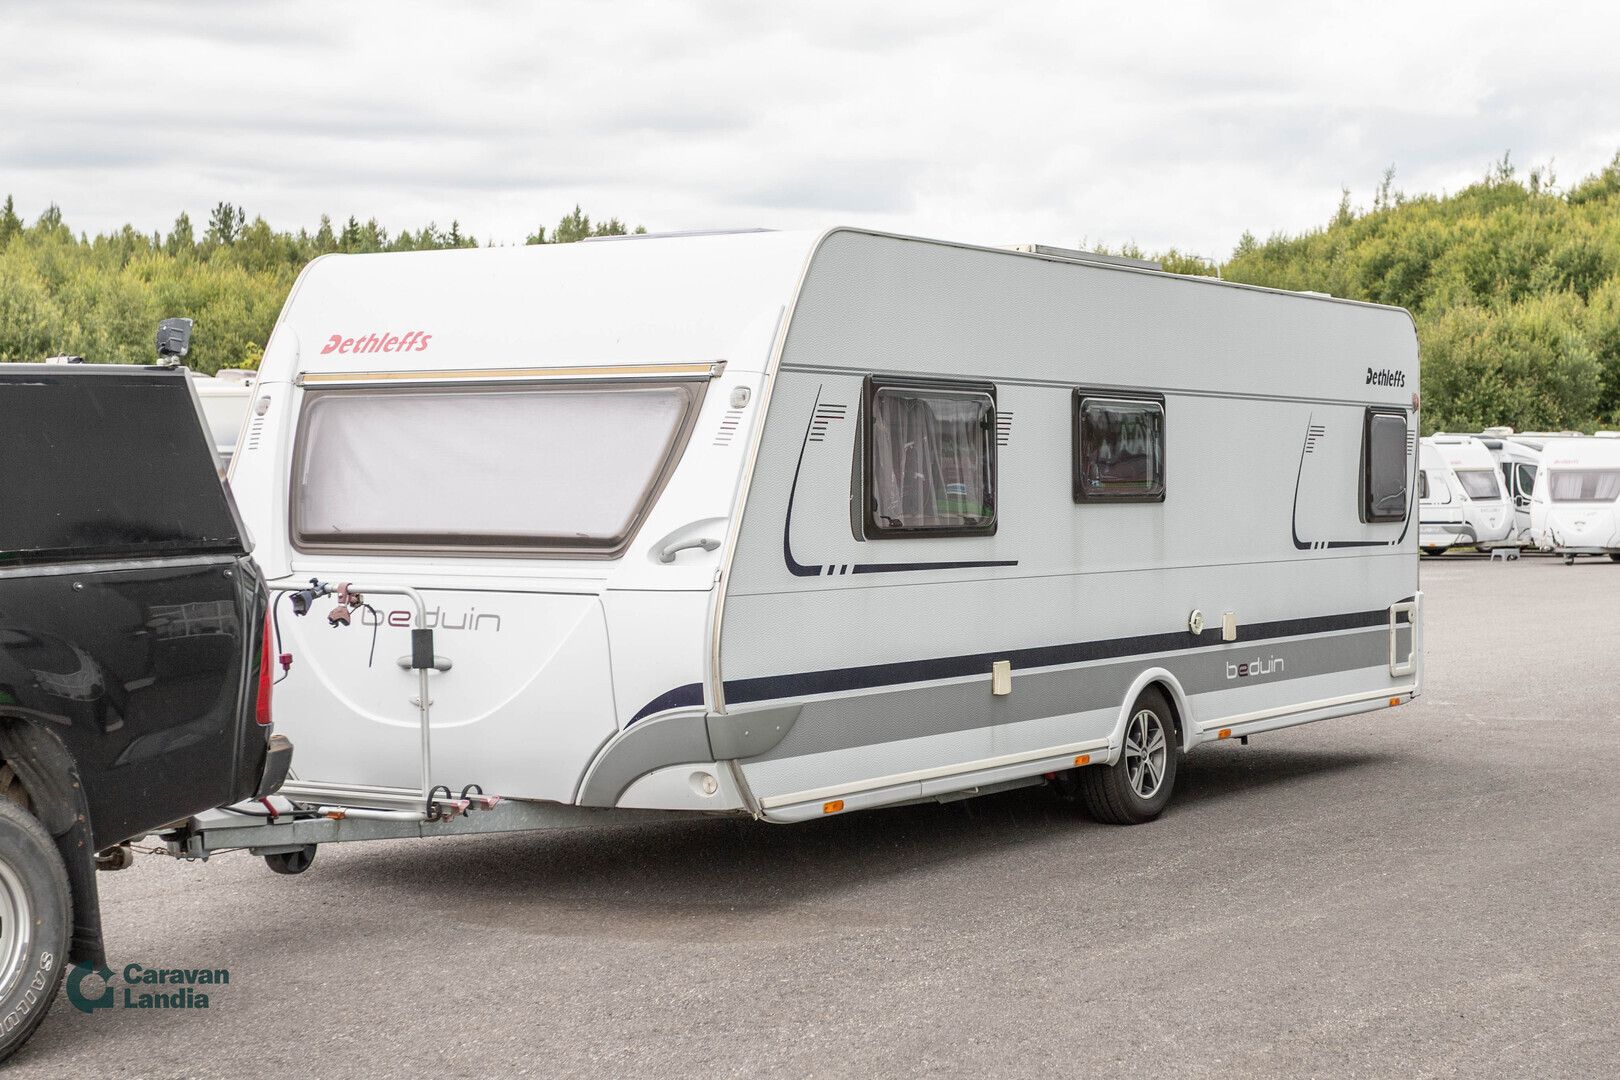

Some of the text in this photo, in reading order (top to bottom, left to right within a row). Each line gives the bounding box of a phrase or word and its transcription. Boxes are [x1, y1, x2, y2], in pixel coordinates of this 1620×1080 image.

[320, 331, 432, 354] Dethleffs
[1366, 367, 1405, 387] Dethleffs
[1226, 655, 1284, 679] beduin
